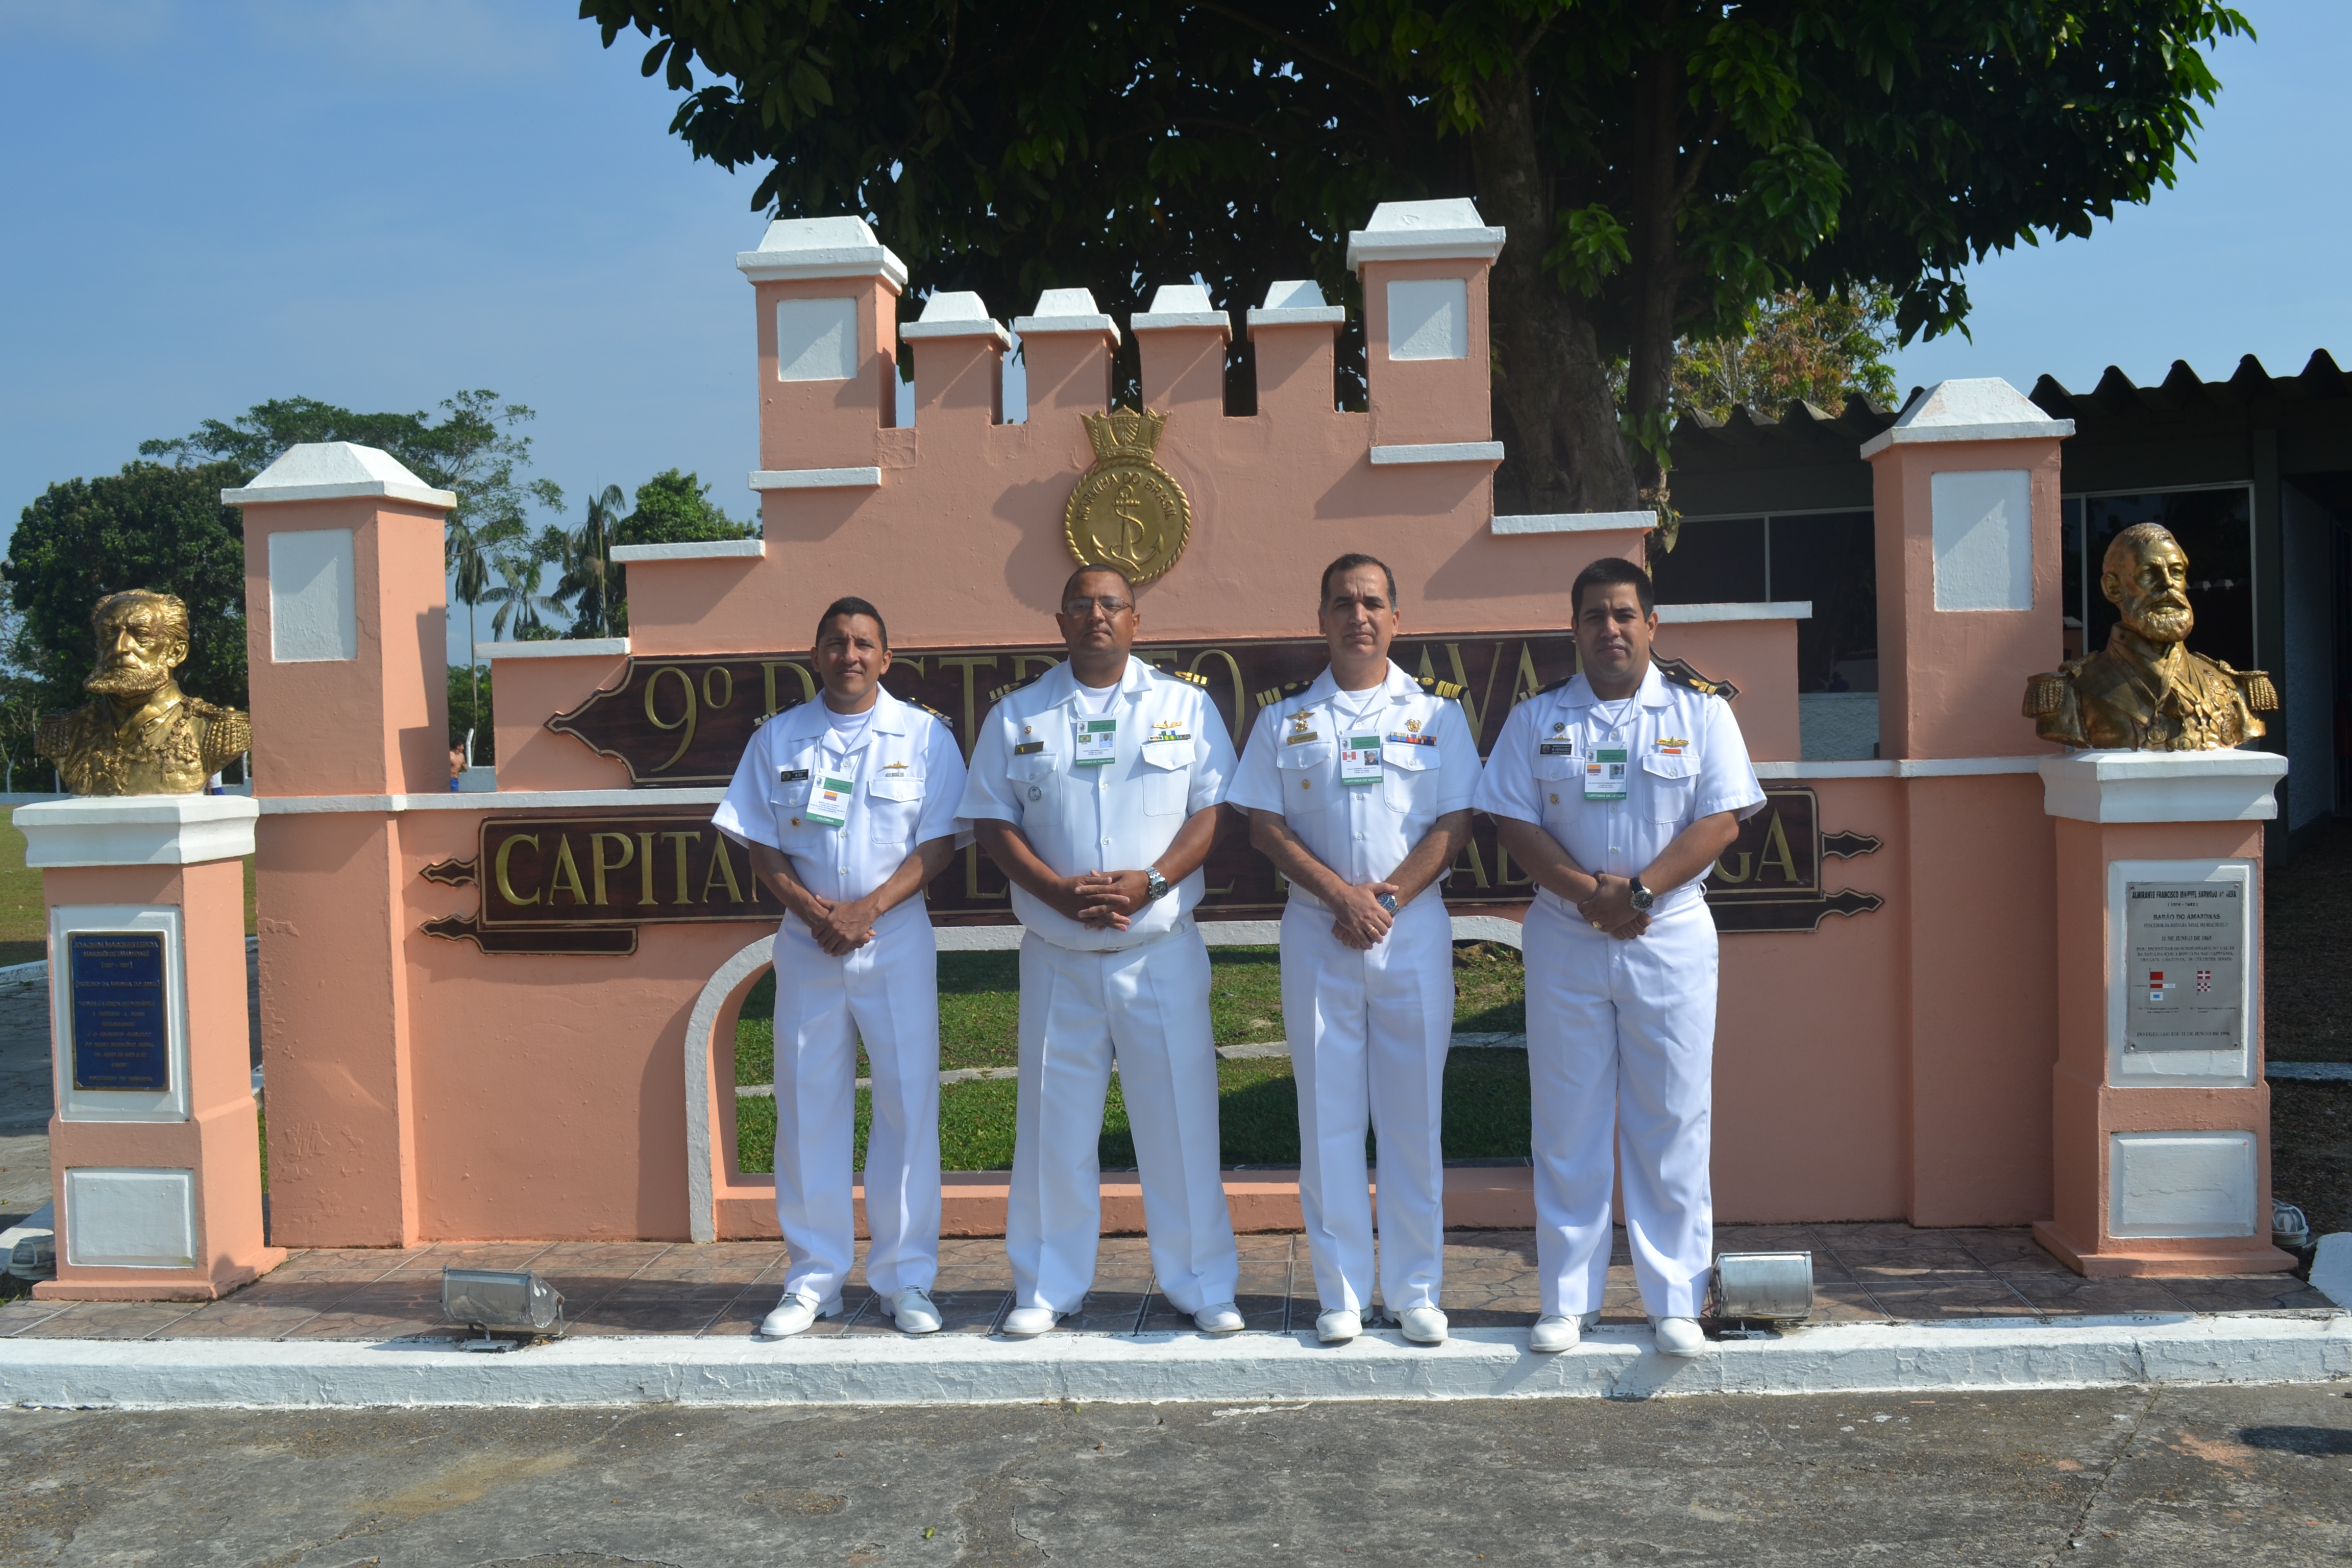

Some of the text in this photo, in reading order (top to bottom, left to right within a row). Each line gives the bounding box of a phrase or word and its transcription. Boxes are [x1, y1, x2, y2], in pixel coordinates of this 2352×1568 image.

[1076, 472, 1177, 521] MARINHA DO BRASIL
[495, 830, 761, 906] CAPITA
